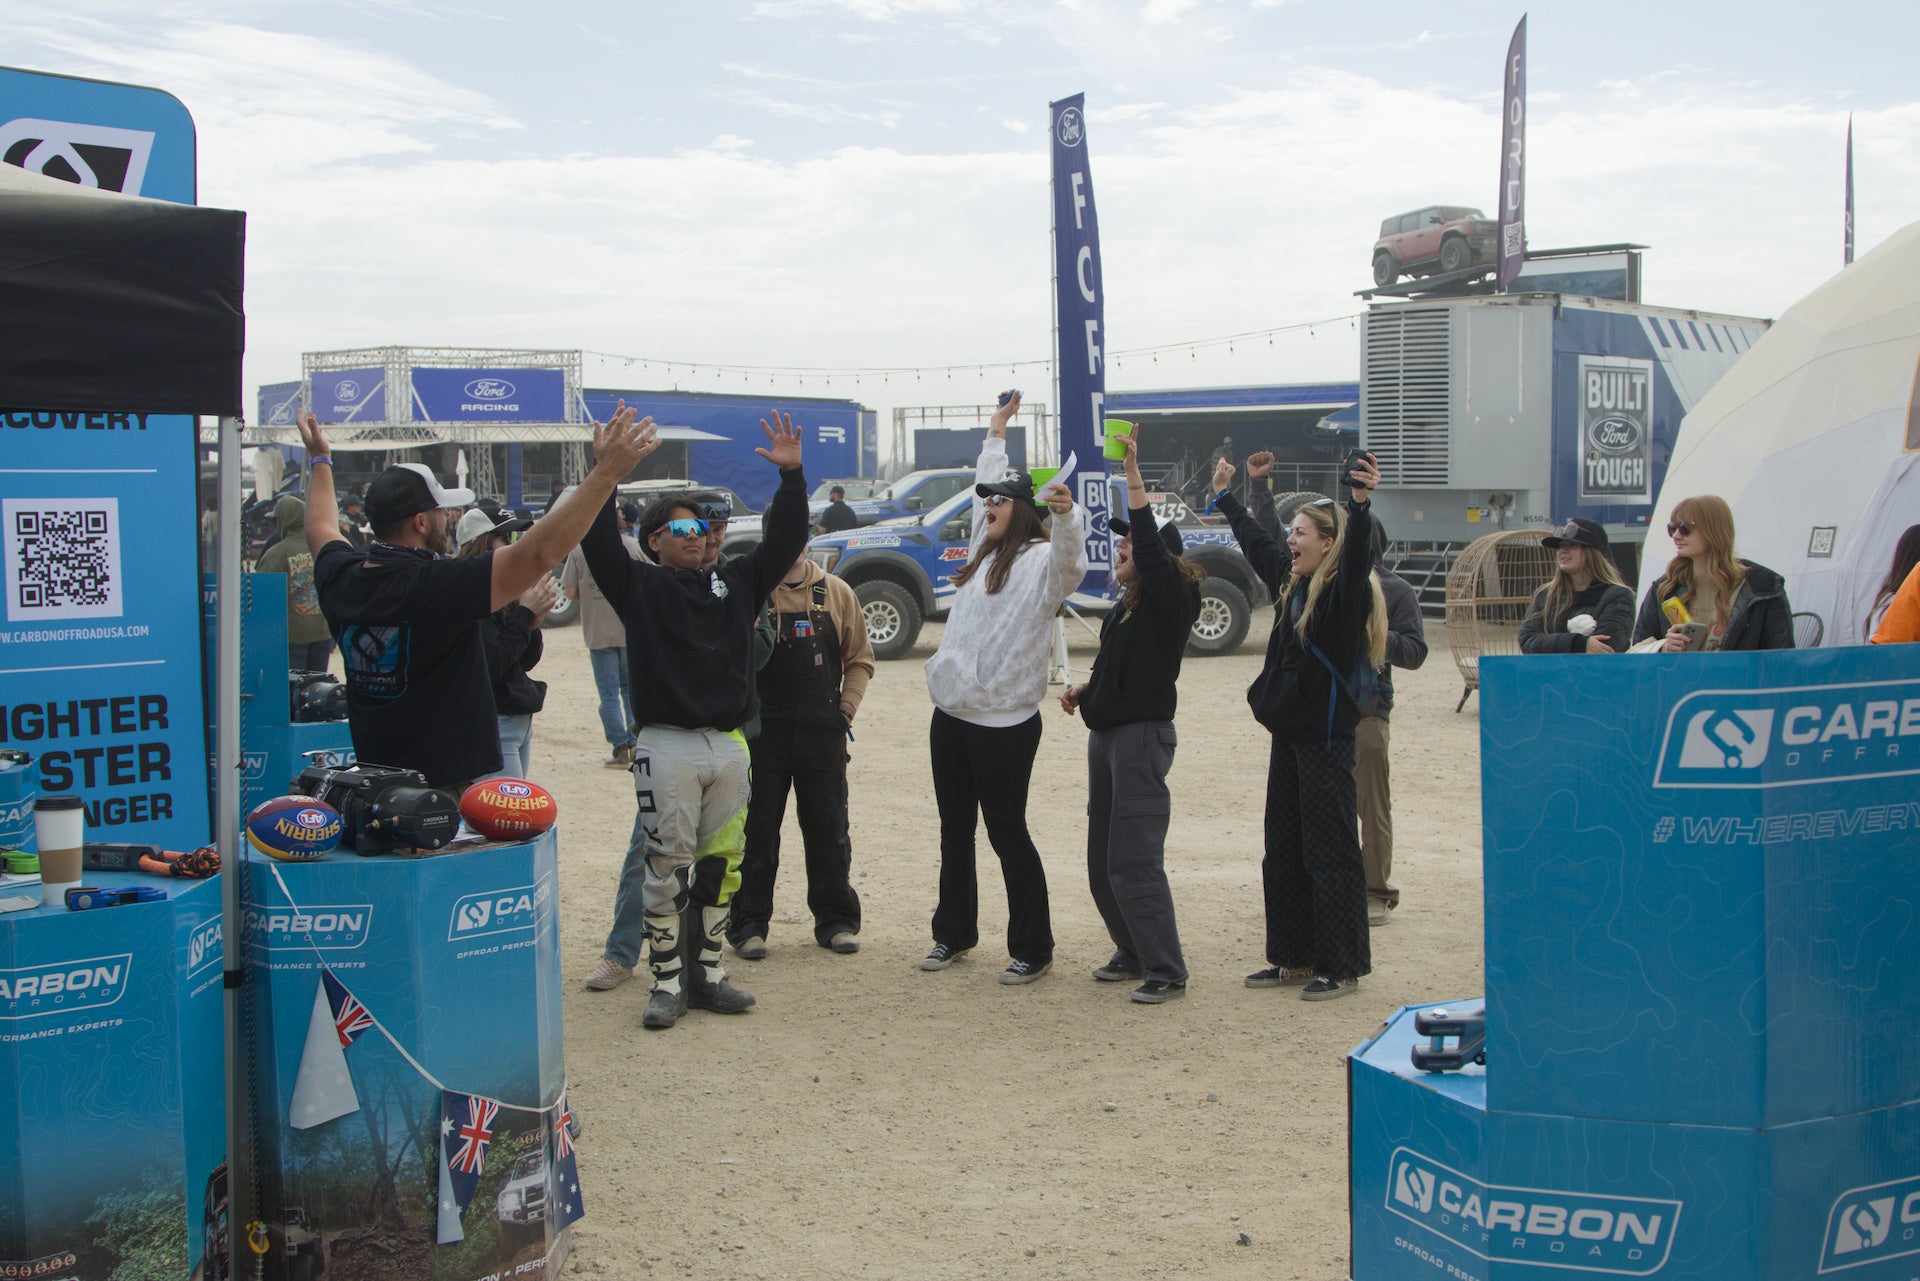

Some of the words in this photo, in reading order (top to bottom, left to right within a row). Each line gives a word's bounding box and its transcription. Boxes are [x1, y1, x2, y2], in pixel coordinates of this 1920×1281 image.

[1062, 112, 1079, 142] Ford
[475, 381, 506, 396] Ford
[1587, 371, 1646, 411] BUILT
[461, 404, 519, 412] RACING
[0, 412, 149, 430] COVERY
[1601, 421, 1630, 444] Ford
[1586, 457, 1644, 488] TOUGH
[847, 537, 900, 548] BFGoodrich
[0, 625, 149, 644] W.CARBONOFFROADUSA.COM
[39, 742, 171, 792] STER
[478, 789, 549, 810] SHERRIN
[502, 785, 528, 795] AFL
[274, 817, 341, 841] SHERRIN
[300, 813, 322, 824] AFL
[457, 946, 499, 959] OFFROAD
[0, 1028, 63, 1042] ORMANCE
[68, 1019, 123, 1033] EXPERTS
[1439, 1181, 1661, 1245] CARBON
[1395, 1236, 1444, 1269] OFFROAD
